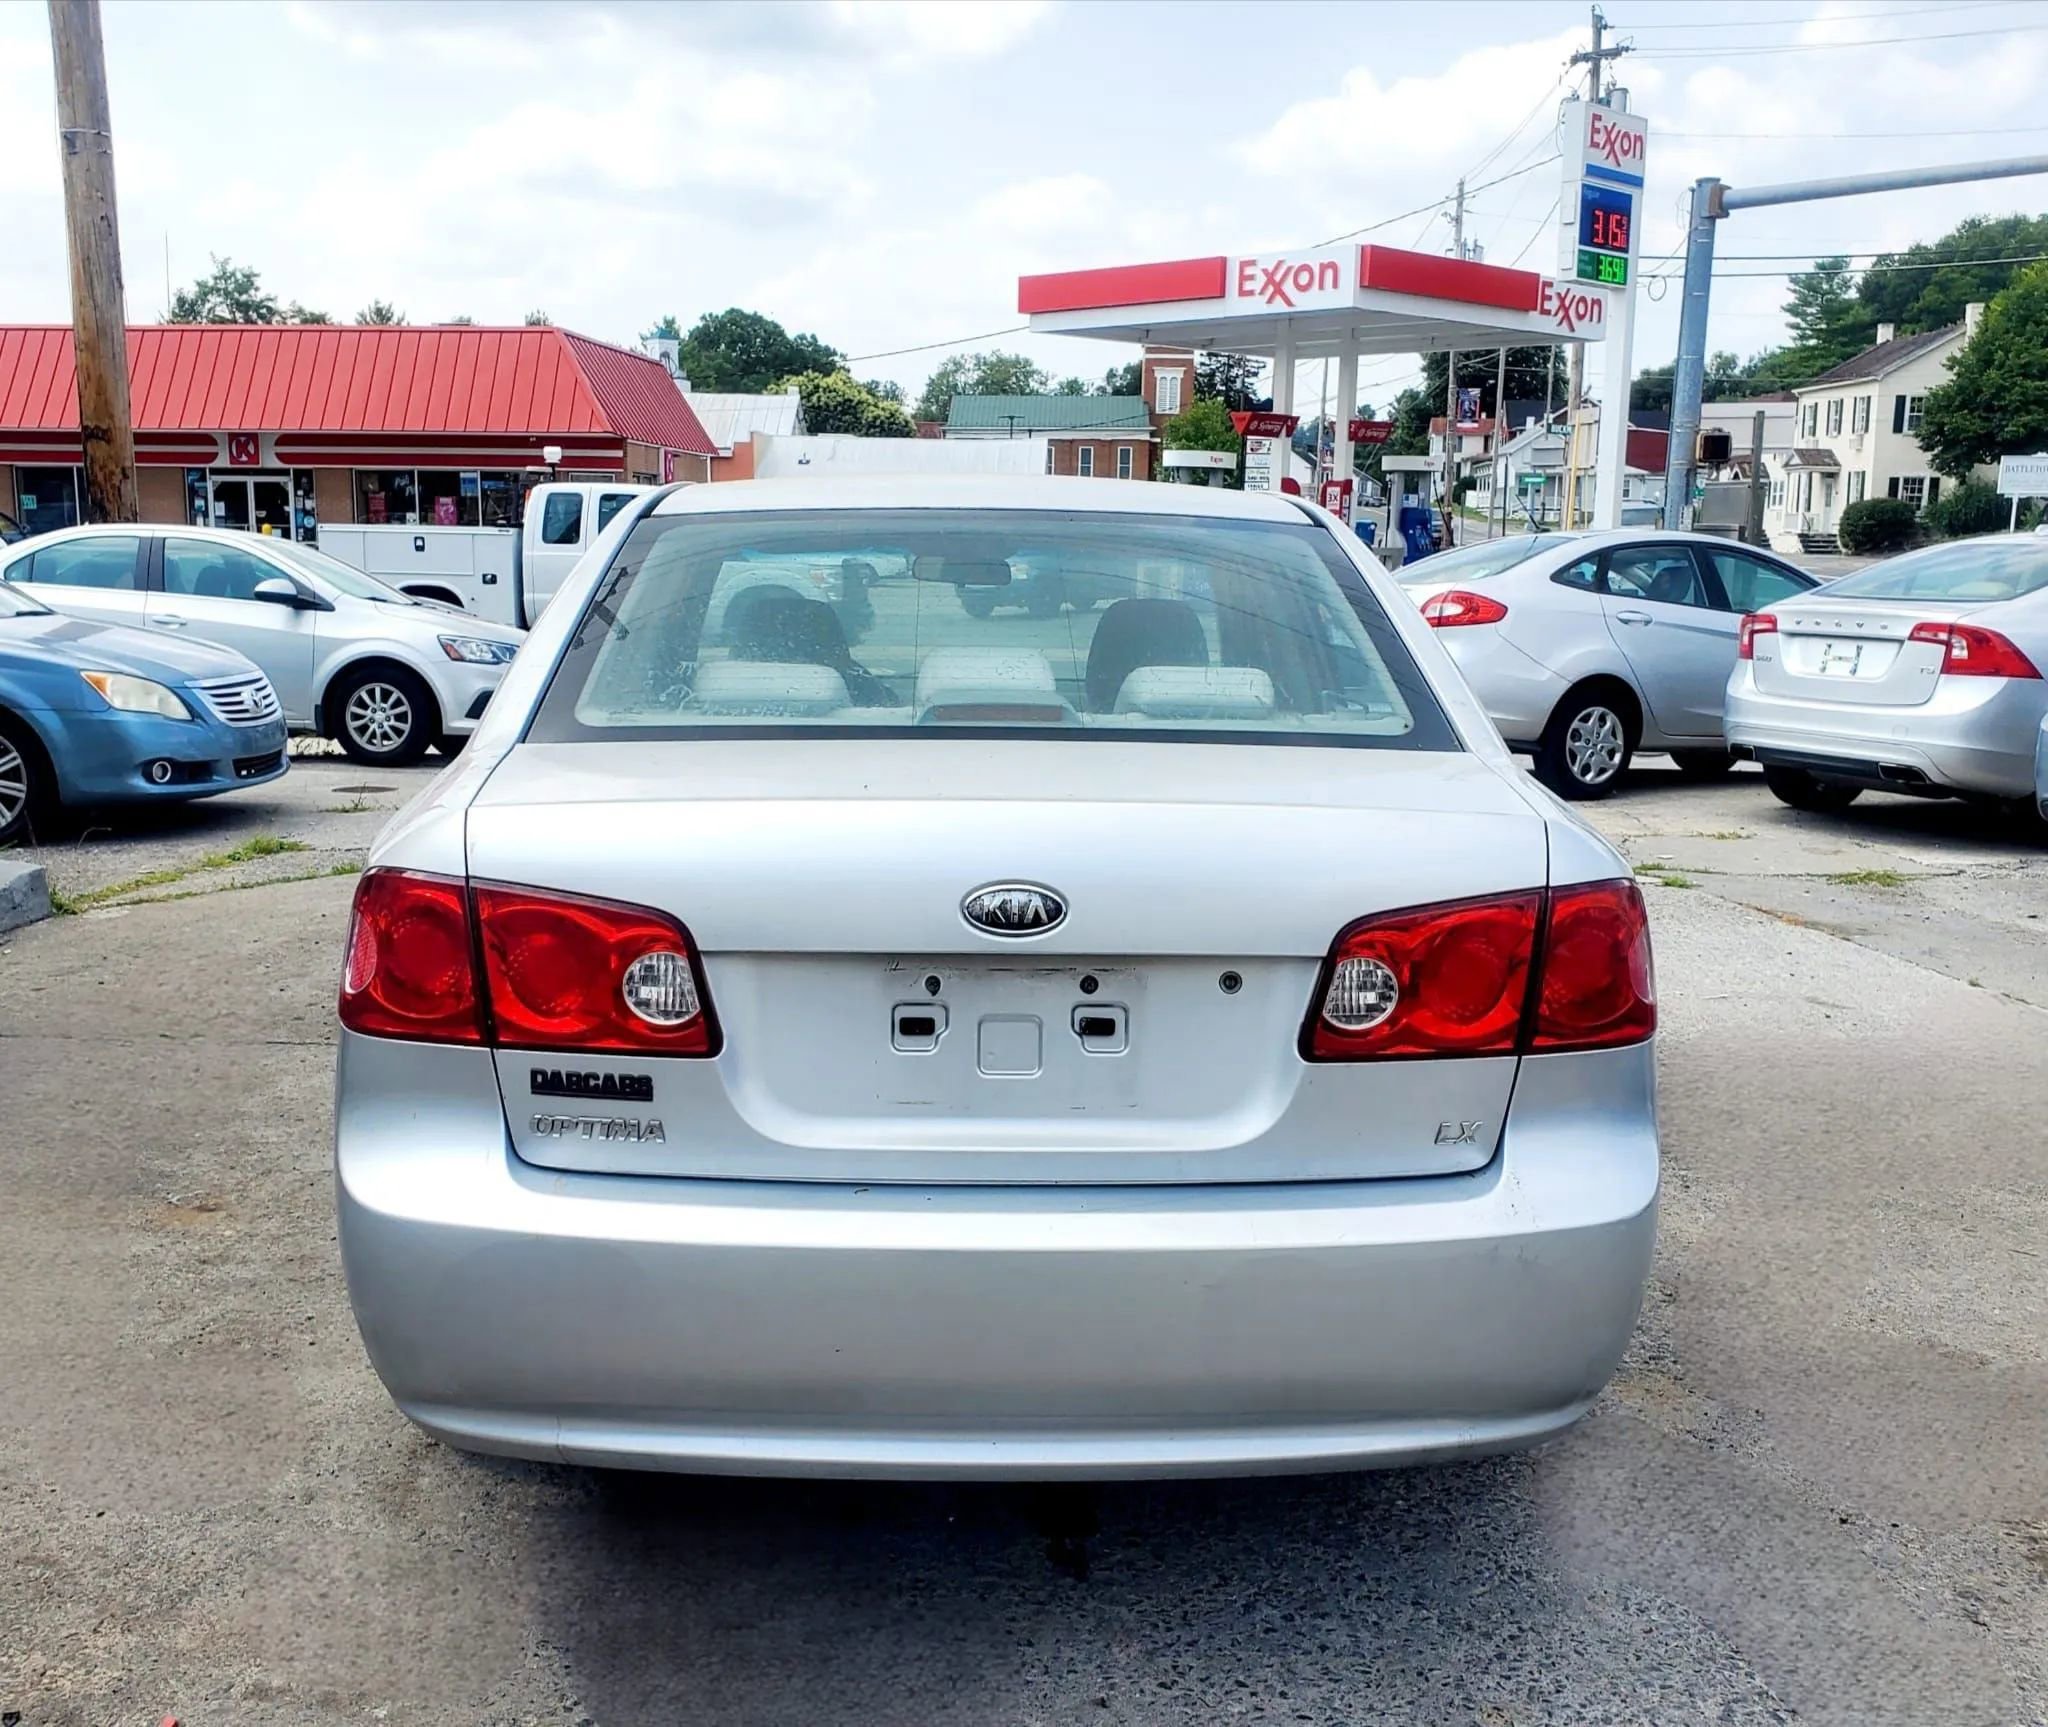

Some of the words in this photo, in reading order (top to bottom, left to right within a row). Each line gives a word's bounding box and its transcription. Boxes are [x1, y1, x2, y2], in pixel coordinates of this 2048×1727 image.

[1589, 112, 1644, 167] Exxon
[1238, 259, 1339, 307] Exxon
[1540, 280, 1602, 333] Exxon
[980, 890, 1049, 923] KIA
[529, 1114, 666, 1143] OPTIMA
[1434, 1121, 1483, 1145] LX
